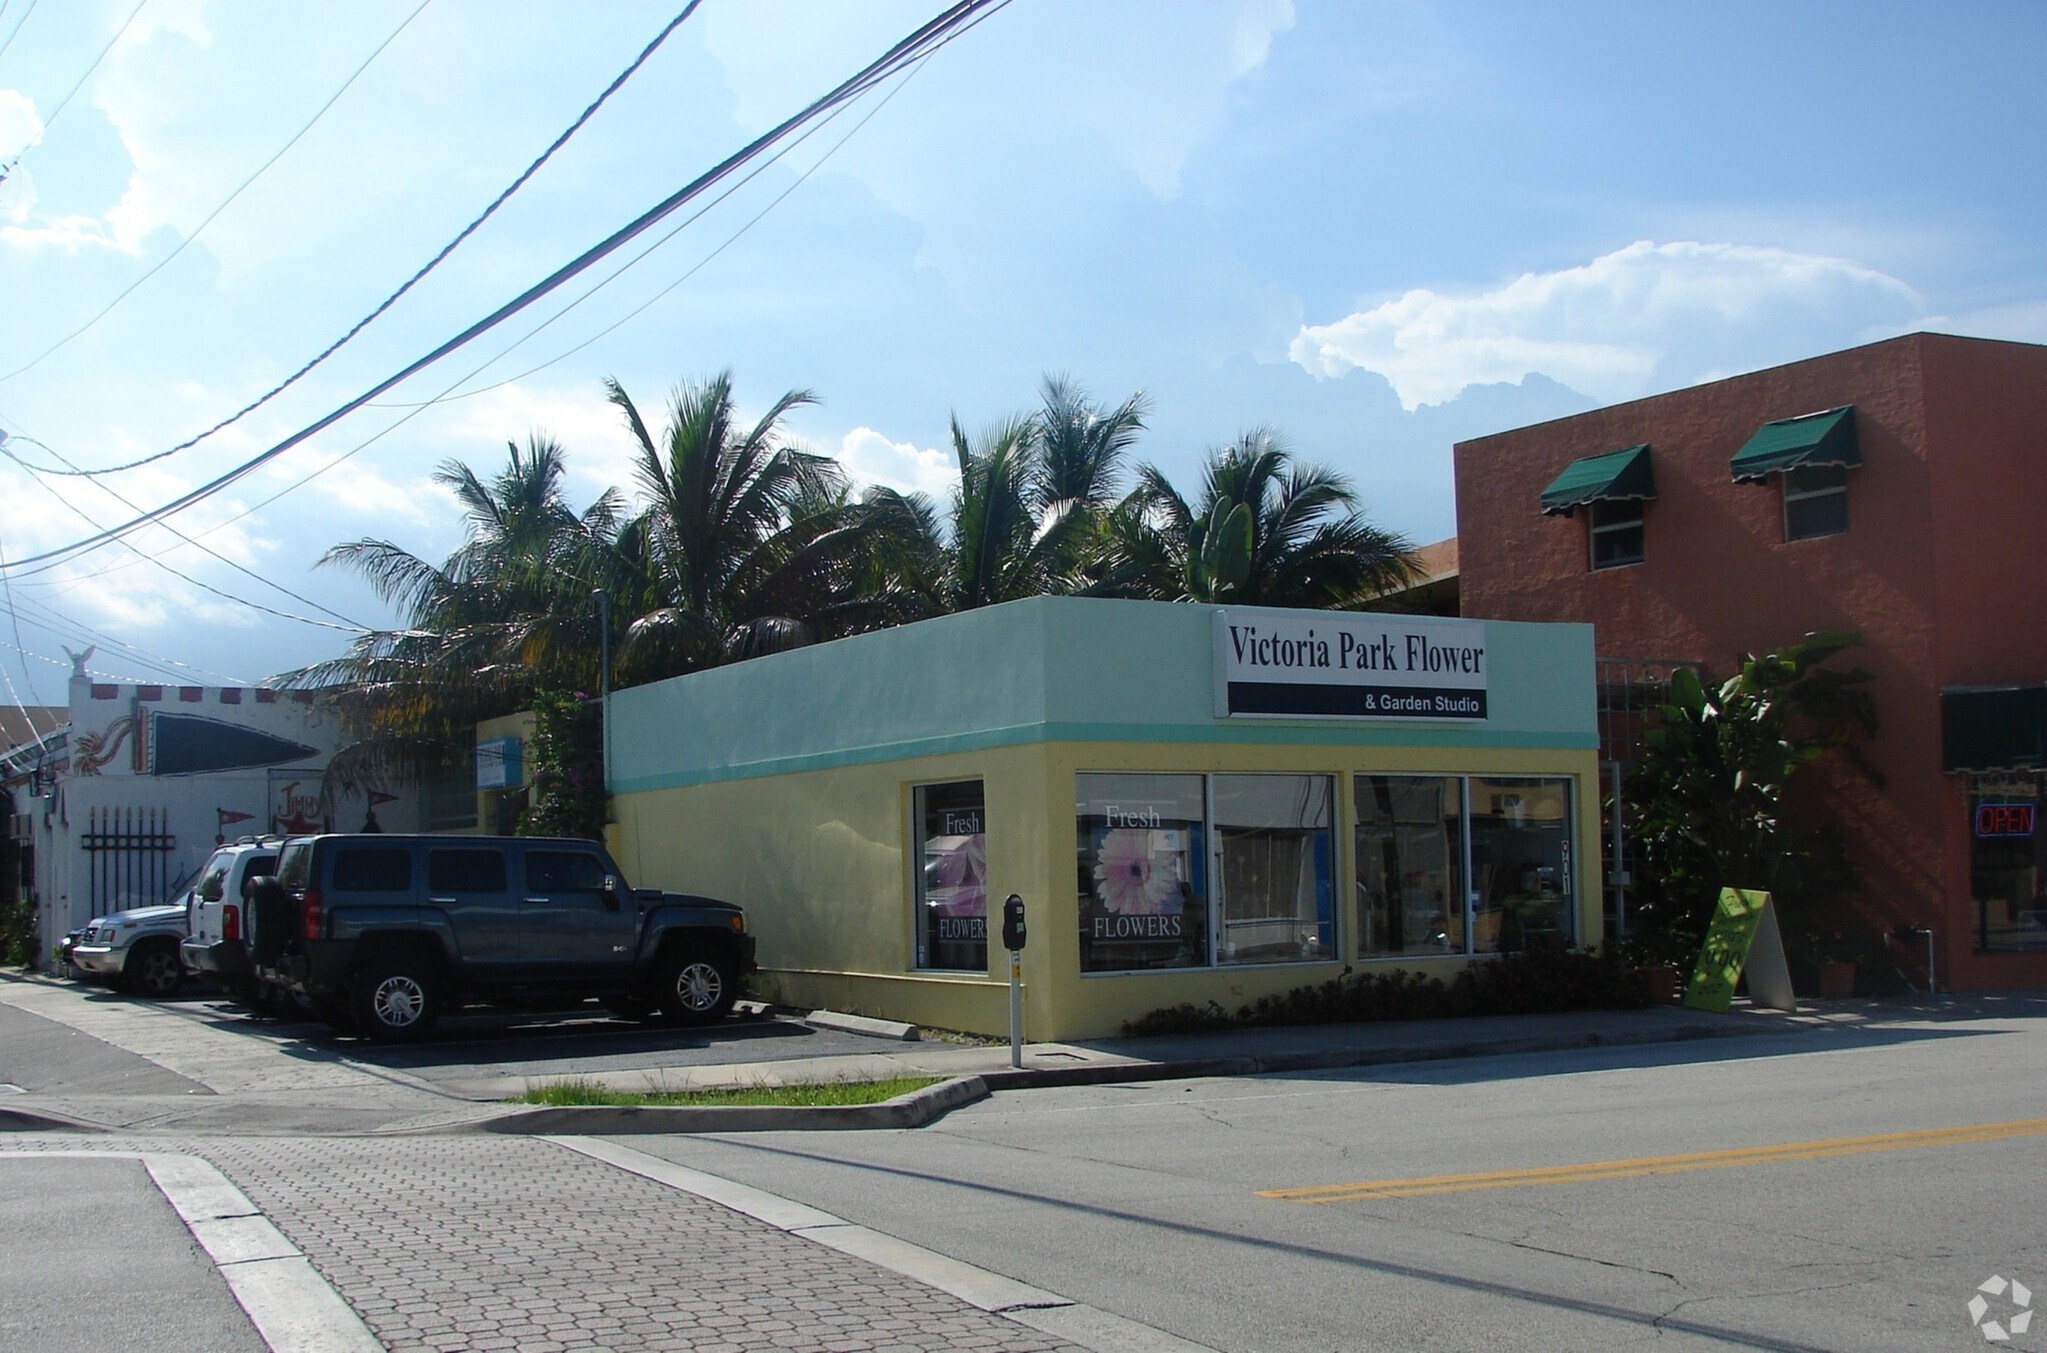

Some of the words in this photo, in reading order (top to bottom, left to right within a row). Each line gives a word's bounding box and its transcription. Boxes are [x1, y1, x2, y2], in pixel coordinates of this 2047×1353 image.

[1229, 626, 1330, 668] Victoria
[1338, 632, 1398, 671] Park
[1405, 635, 1484, 674] Flower
[1365, 694, 1377, 710] &
[1380, 694, 1431, 712] Garden
[1435, 697, 1479, 713] Studio
[946, 812, 980, 834] Fresh
[1105, 805, 1160, 828] Fresh
[1980, 807, 2033, 833] OPEN
[1094, 916, 1181, 938] FLOWERS
